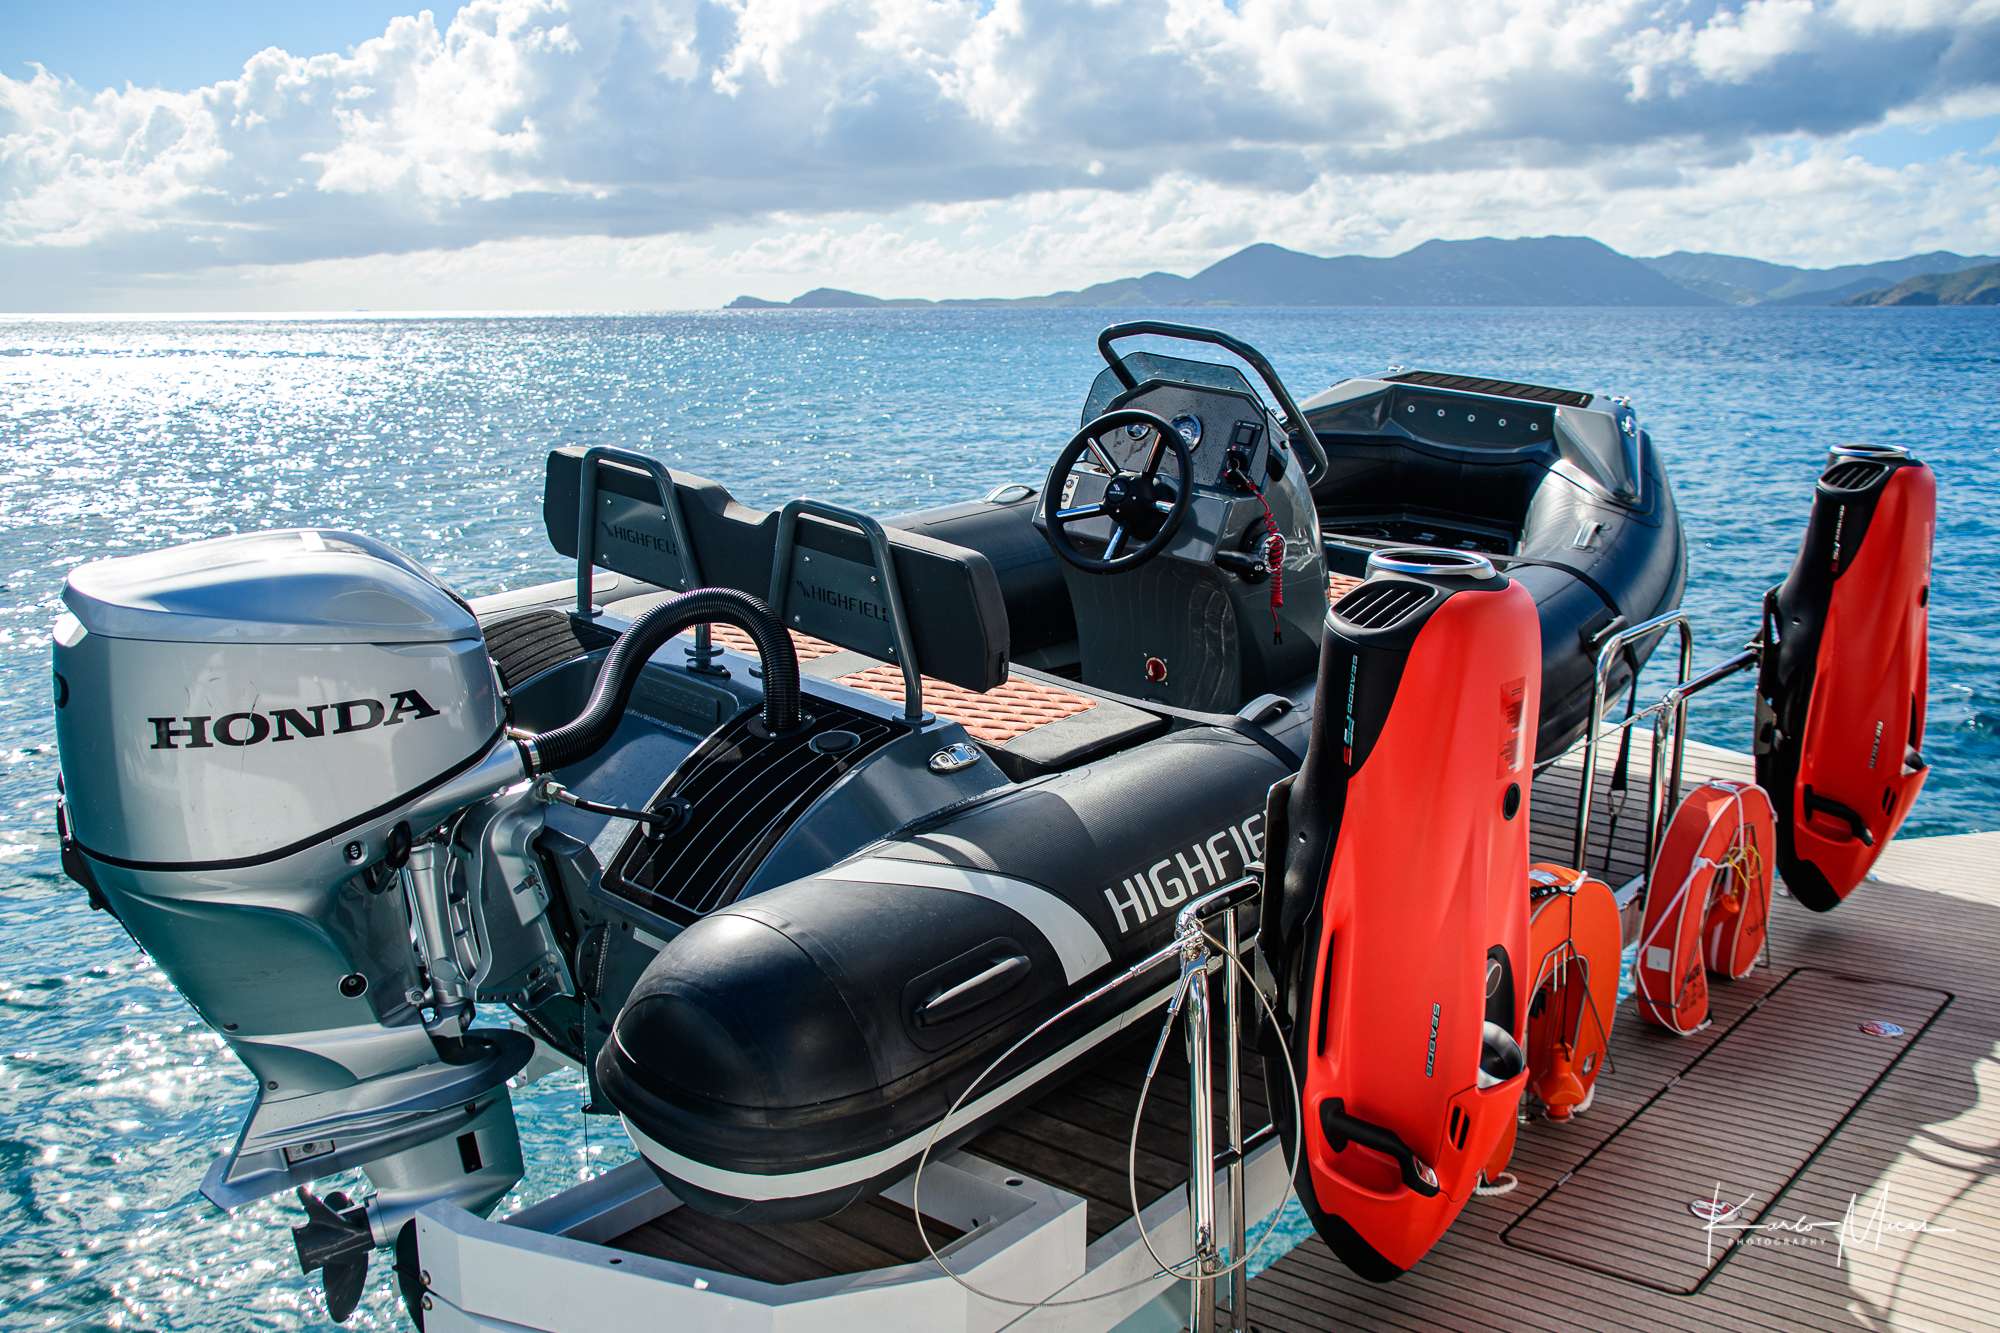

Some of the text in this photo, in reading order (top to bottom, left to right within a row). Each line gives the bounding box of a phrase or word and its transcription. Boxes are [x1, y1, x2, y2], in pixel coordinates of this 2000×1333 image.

[147, 689, 441, 749] HONDA
[1103, 810, 1268, 934] HIGHFIE
[1425, 1003, 1441, 1078] SEABOB
